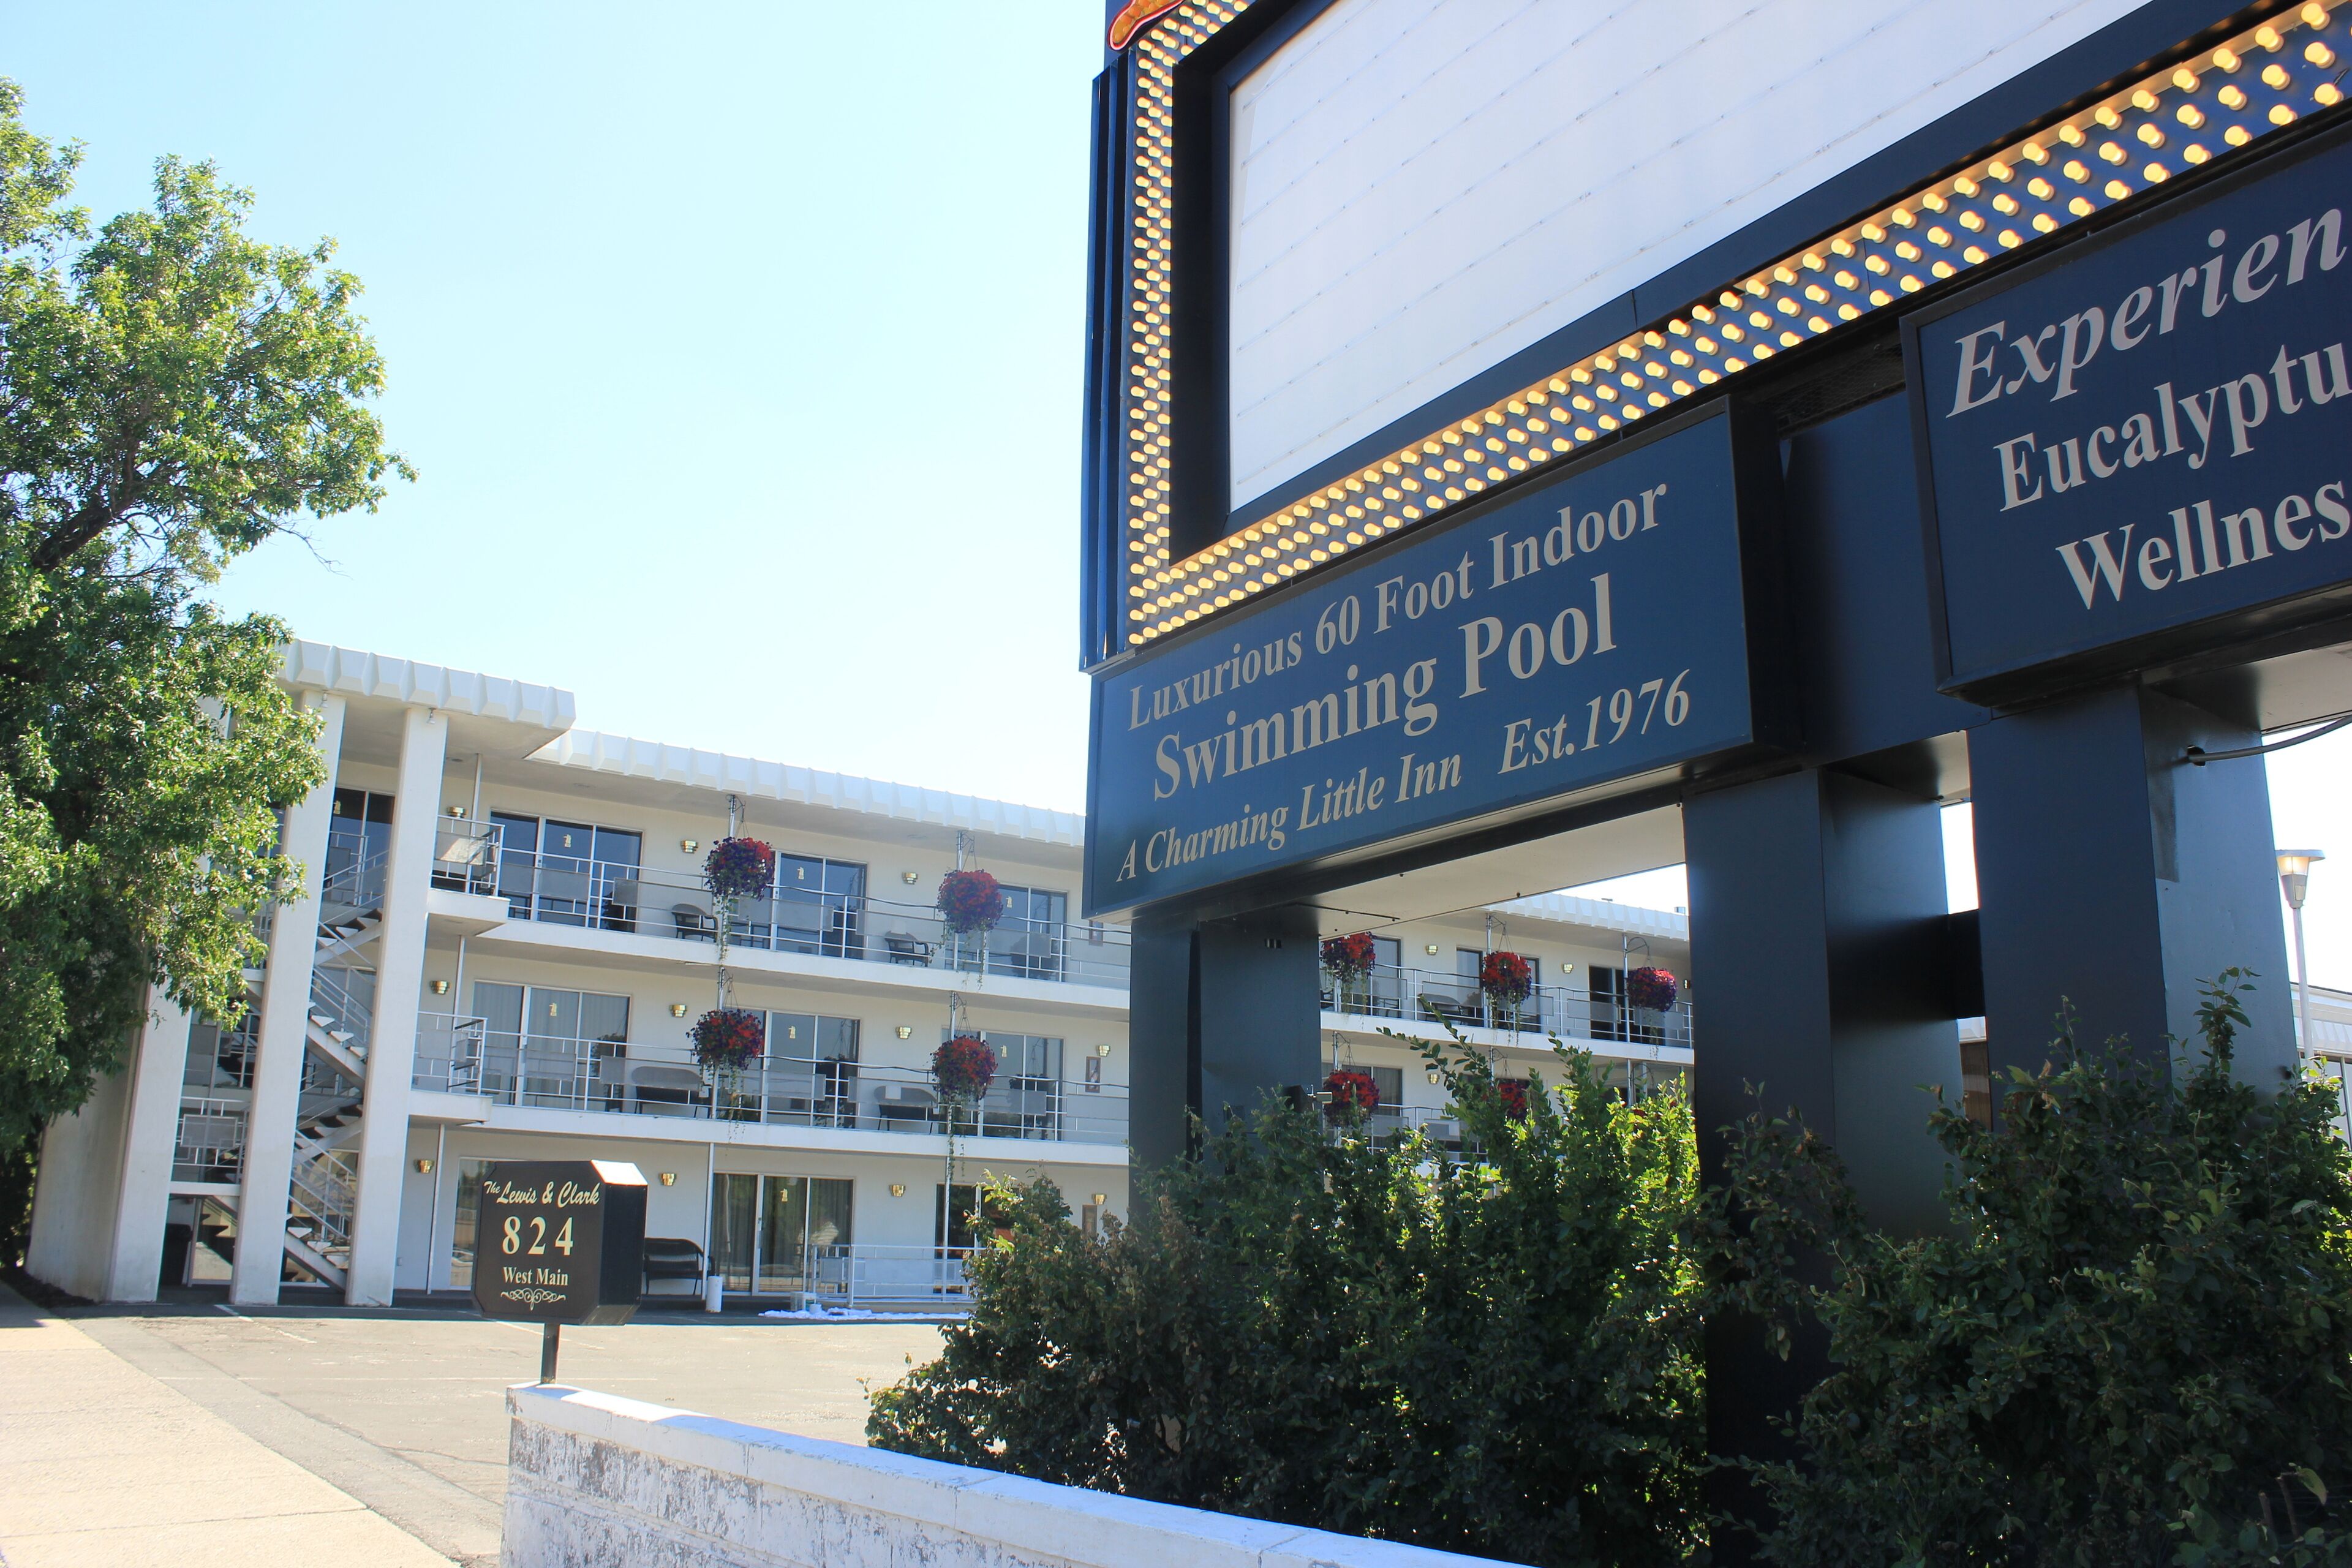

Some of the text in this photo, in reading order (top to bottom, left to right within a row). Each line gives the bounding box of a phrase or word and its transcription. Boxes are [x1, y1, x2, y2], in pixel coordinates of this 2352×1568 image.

[1945, 208, 2347, 418] Experien
[1992, 342, 2352, 512] Eucalyptu
[1128, 483, 1667, 731] Luxurious 60 Foot Indoor
[2055, 481, 2351, 610] Wellnes
[1154, 573, 1617, 801] Swimming Pool
[1116, 840, 1136, 883] A
[1145, 804, 1289, 873] Charming
[1295, 767, 1385, 831] Little
[1394, 753, 1461, 803] Inn
[483, 1180, 601, 1208] The Lewis & Clark
[502, 1216, 573, 1256] 824
[503, 1267, 568, 1286] West Main
